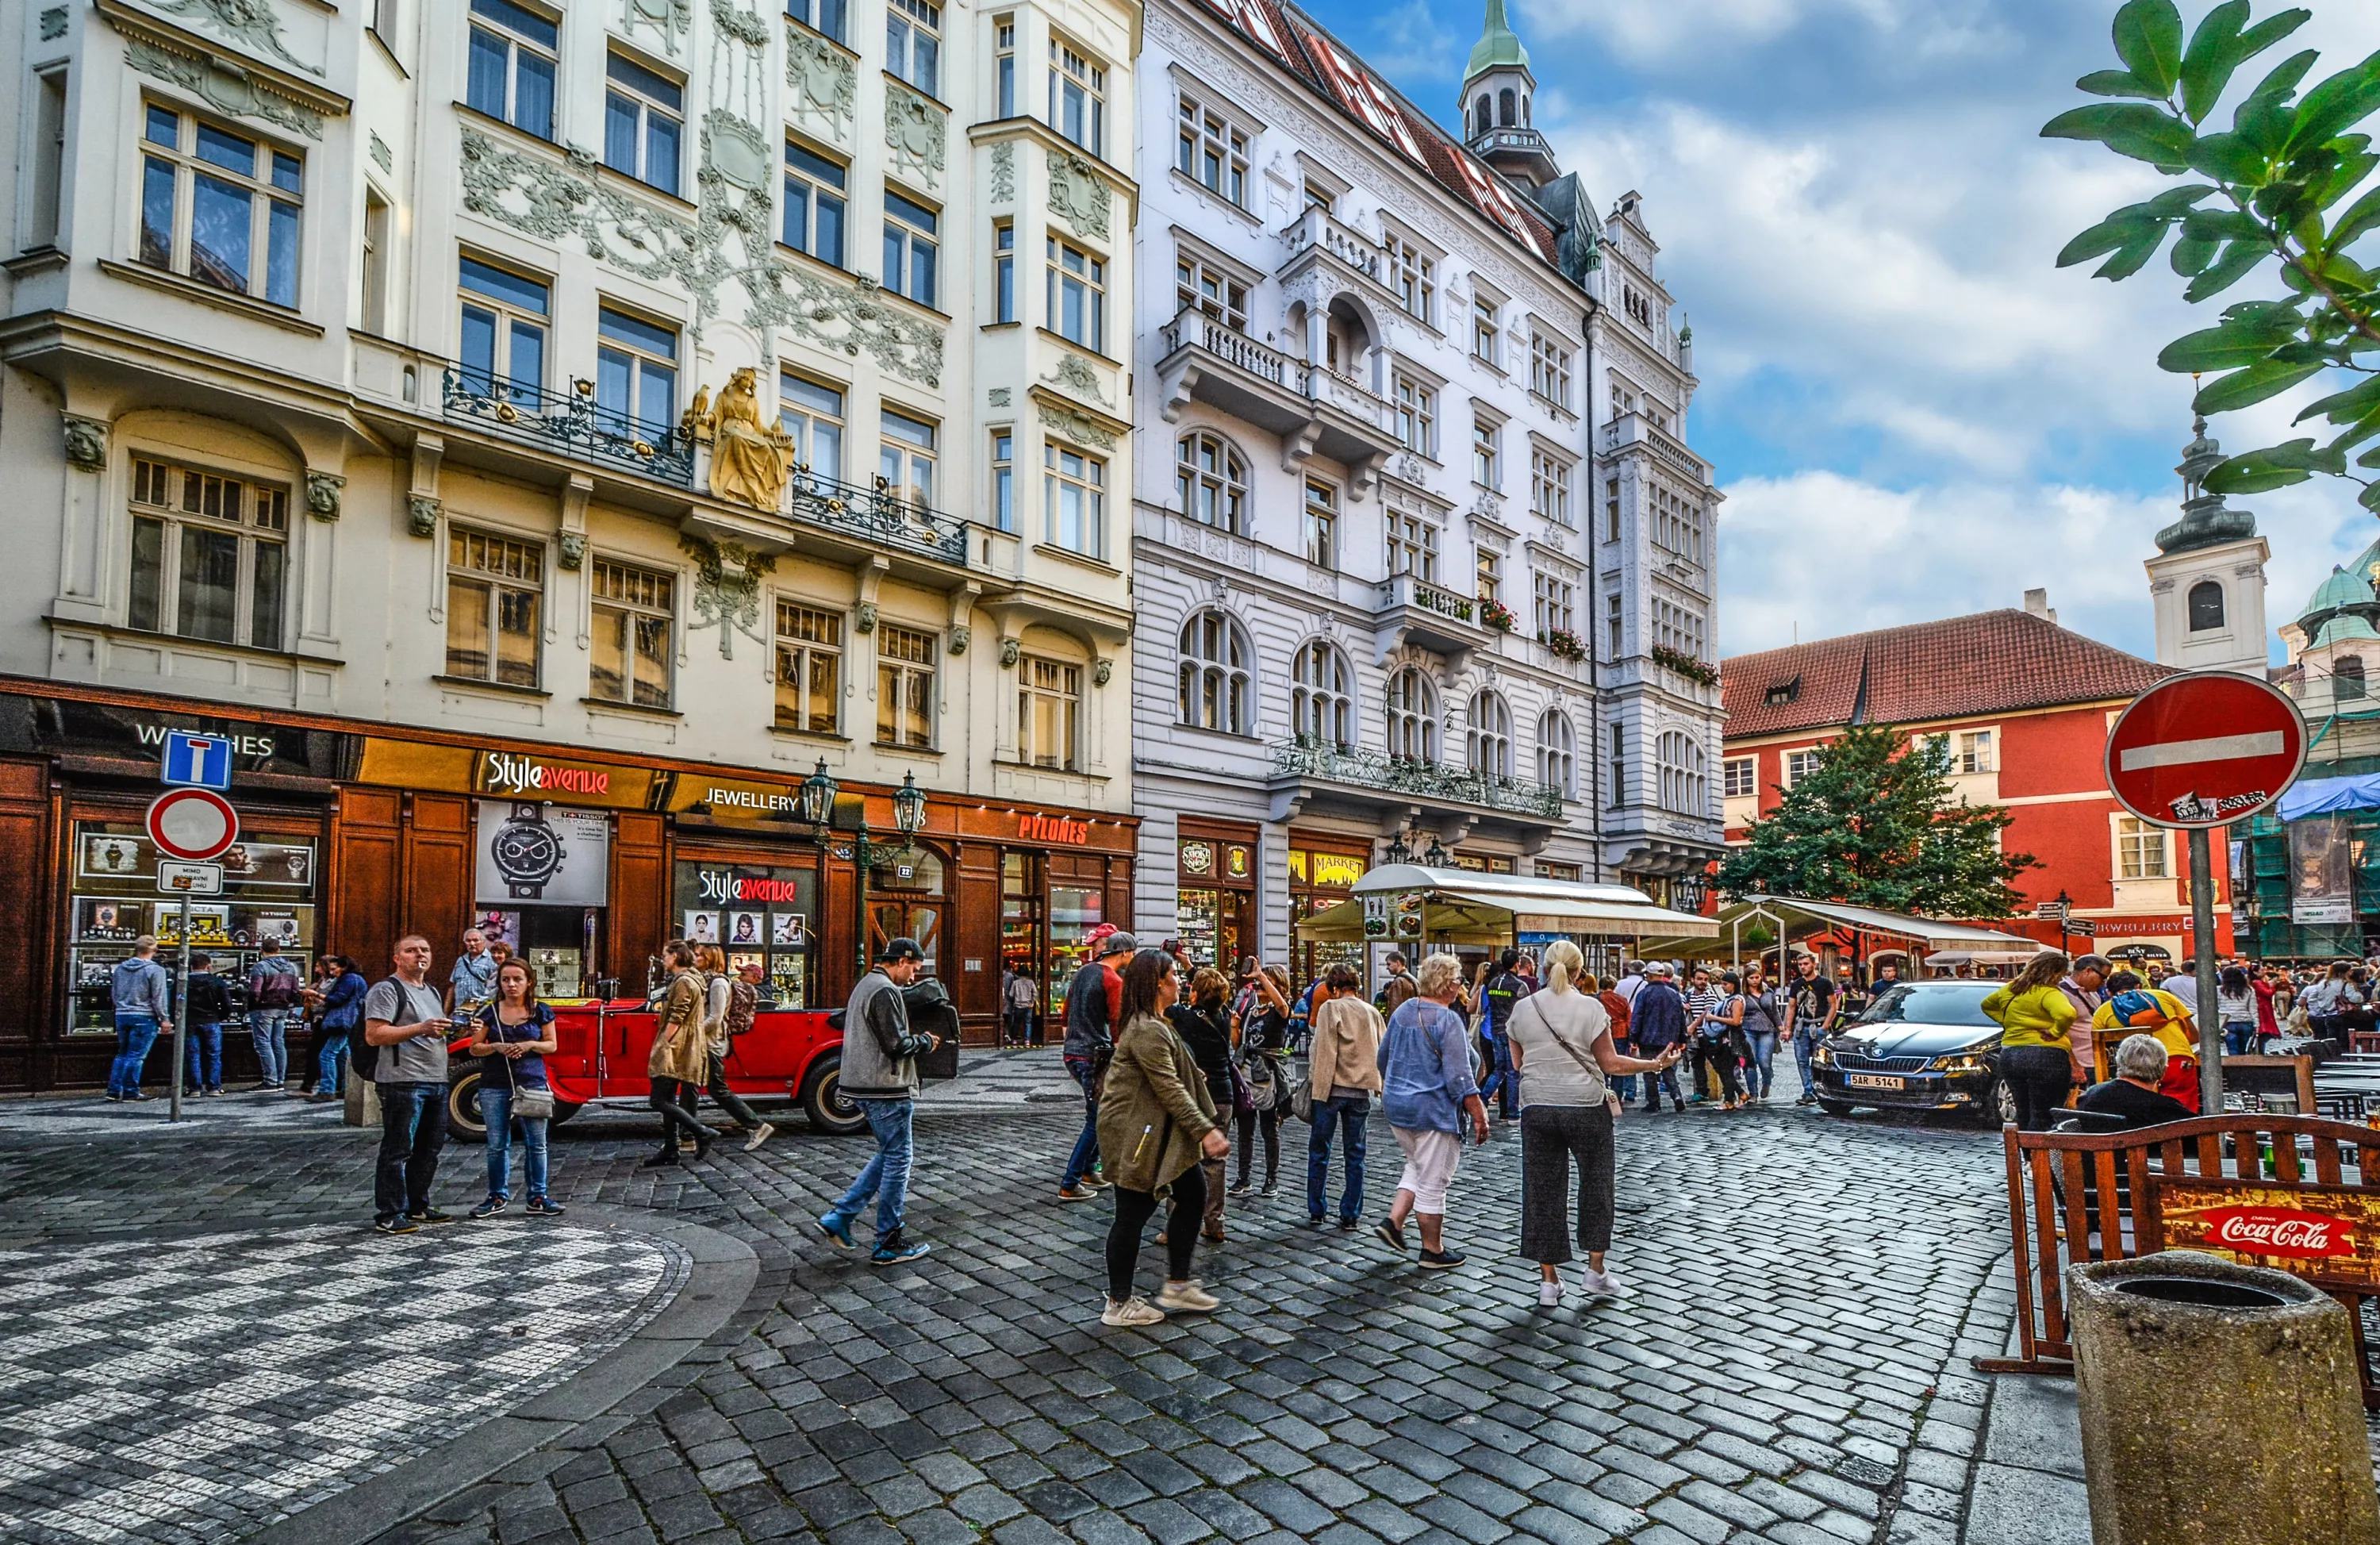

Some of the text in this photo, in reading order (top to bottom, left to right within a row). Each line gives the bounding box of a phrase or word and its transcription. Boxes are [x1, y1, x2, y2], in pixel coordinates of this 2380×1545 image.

[136, 724, 272, 756] WHES
[704, 788, 799, 811] JEWELLERY
[1019, 816, 1088, 844] PYLONES
[1188, 857, 1205, 867] SHOP
[1316, 857, 1363, 879] MARKET
[2095, 923, 2180, 932] JEWELLERY
[1852, 1075, 1898, 1087] 5AR 5141
[2221, 1216, 2331, 1250] Coca-Cola
